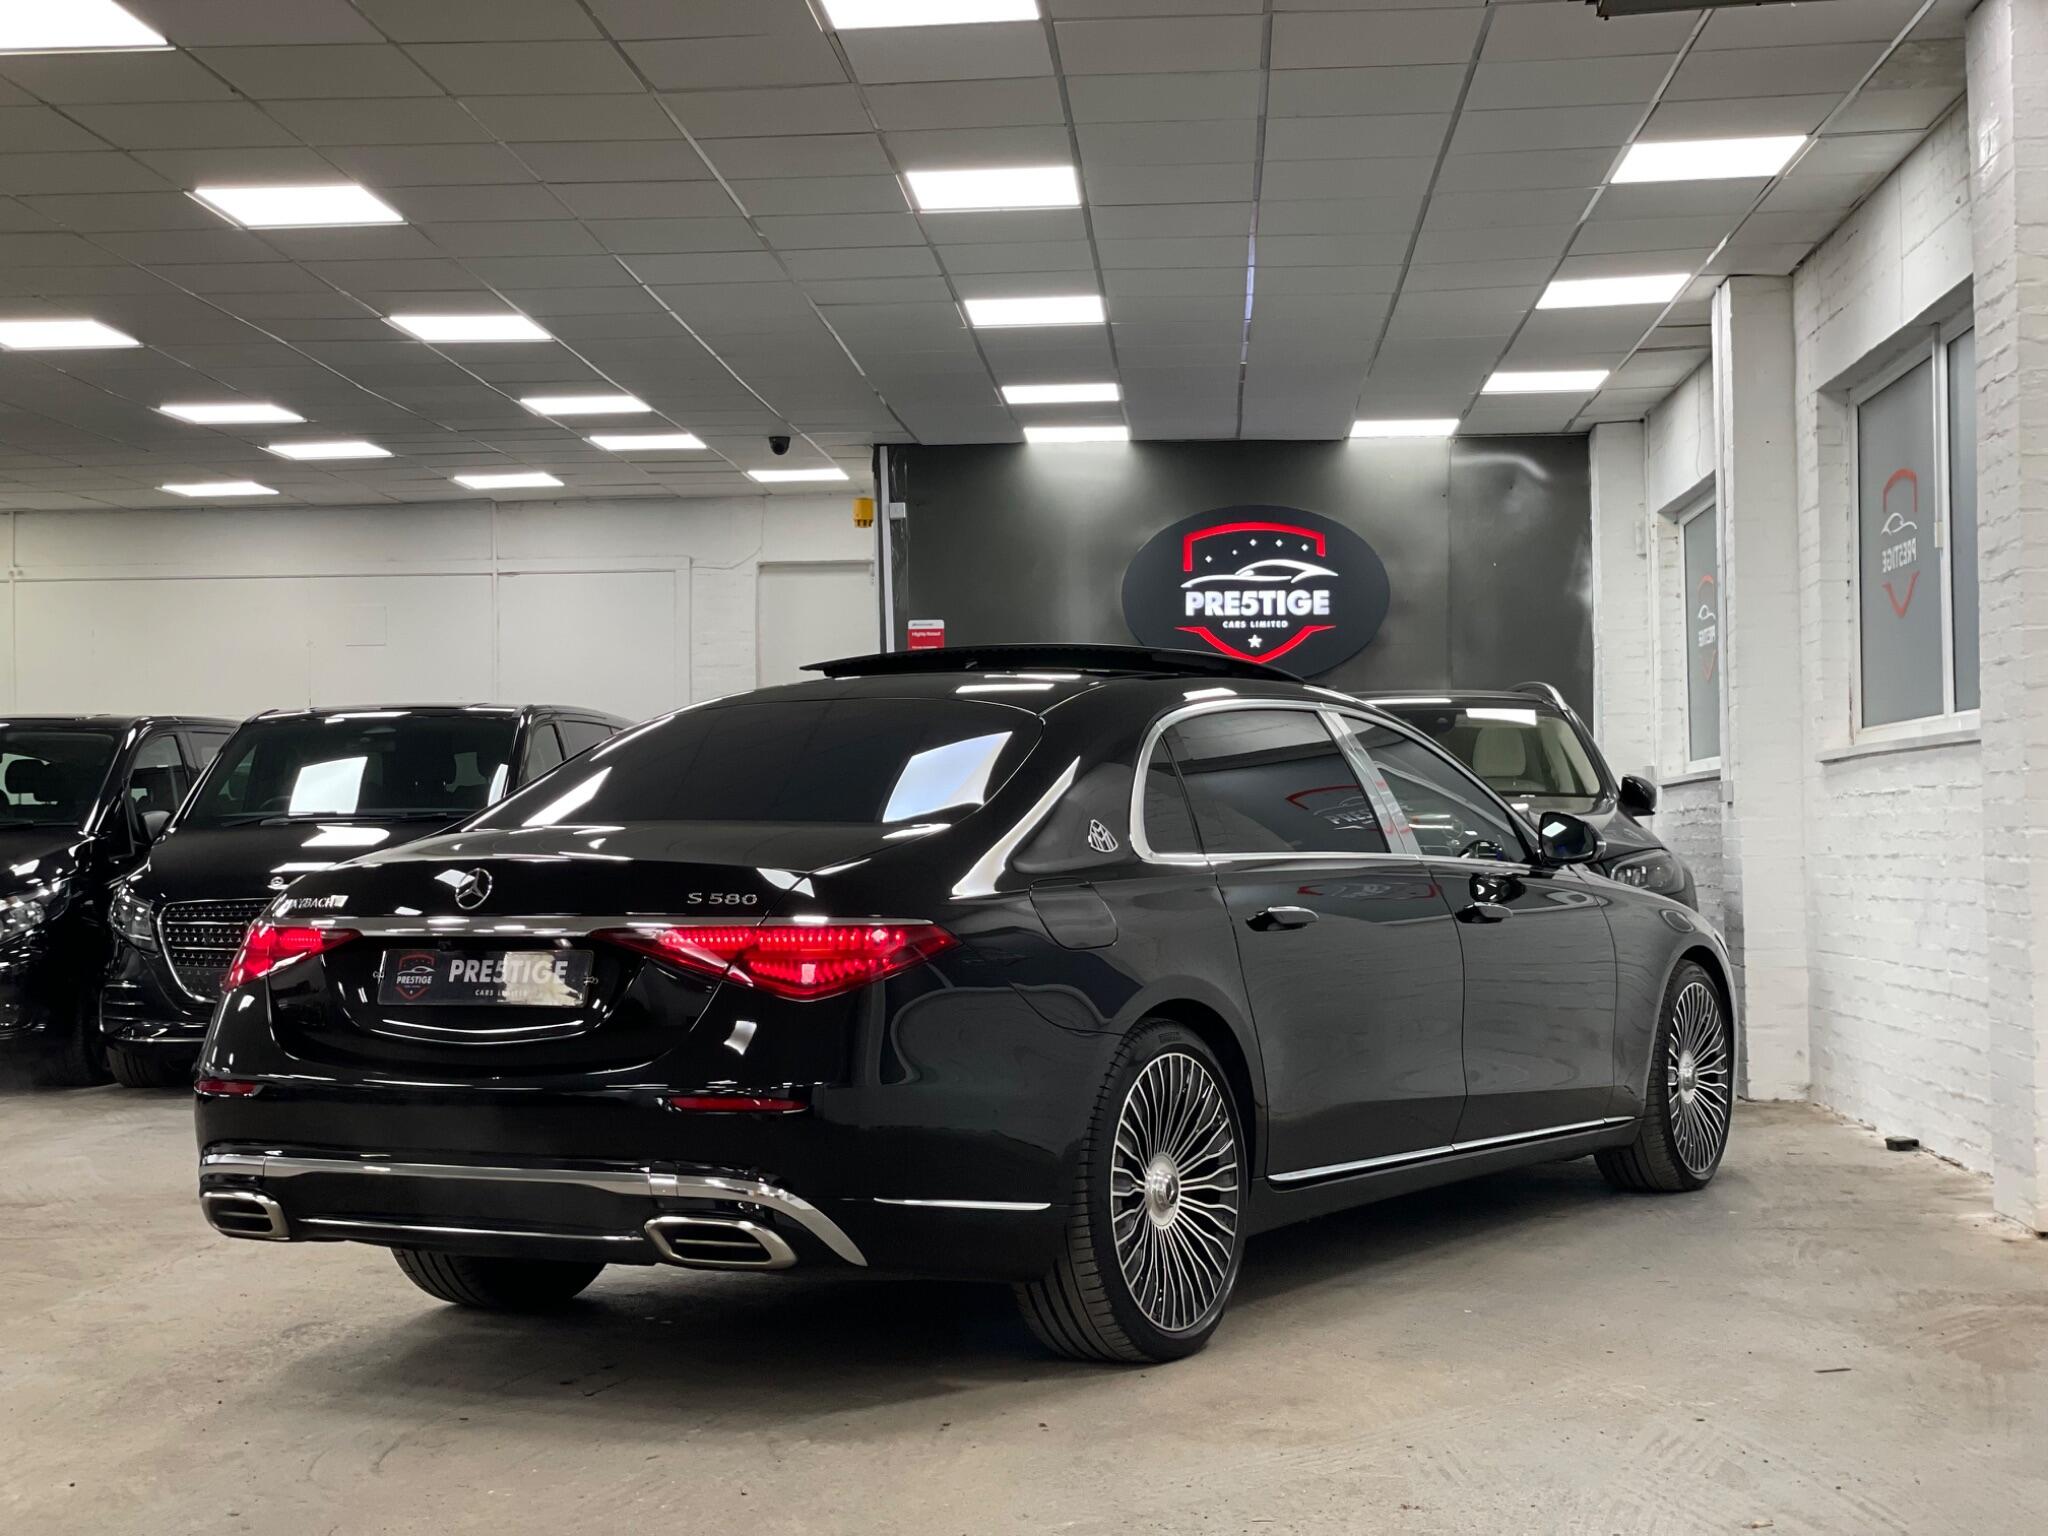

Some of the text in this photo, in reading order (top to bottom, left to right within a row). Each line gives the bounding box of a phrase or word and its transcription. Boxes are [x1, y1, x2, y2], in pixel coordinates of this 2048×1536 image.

[1222, 620, 1289, 628] CARS LIMITED
[687, 892, 758, 905] S 580
